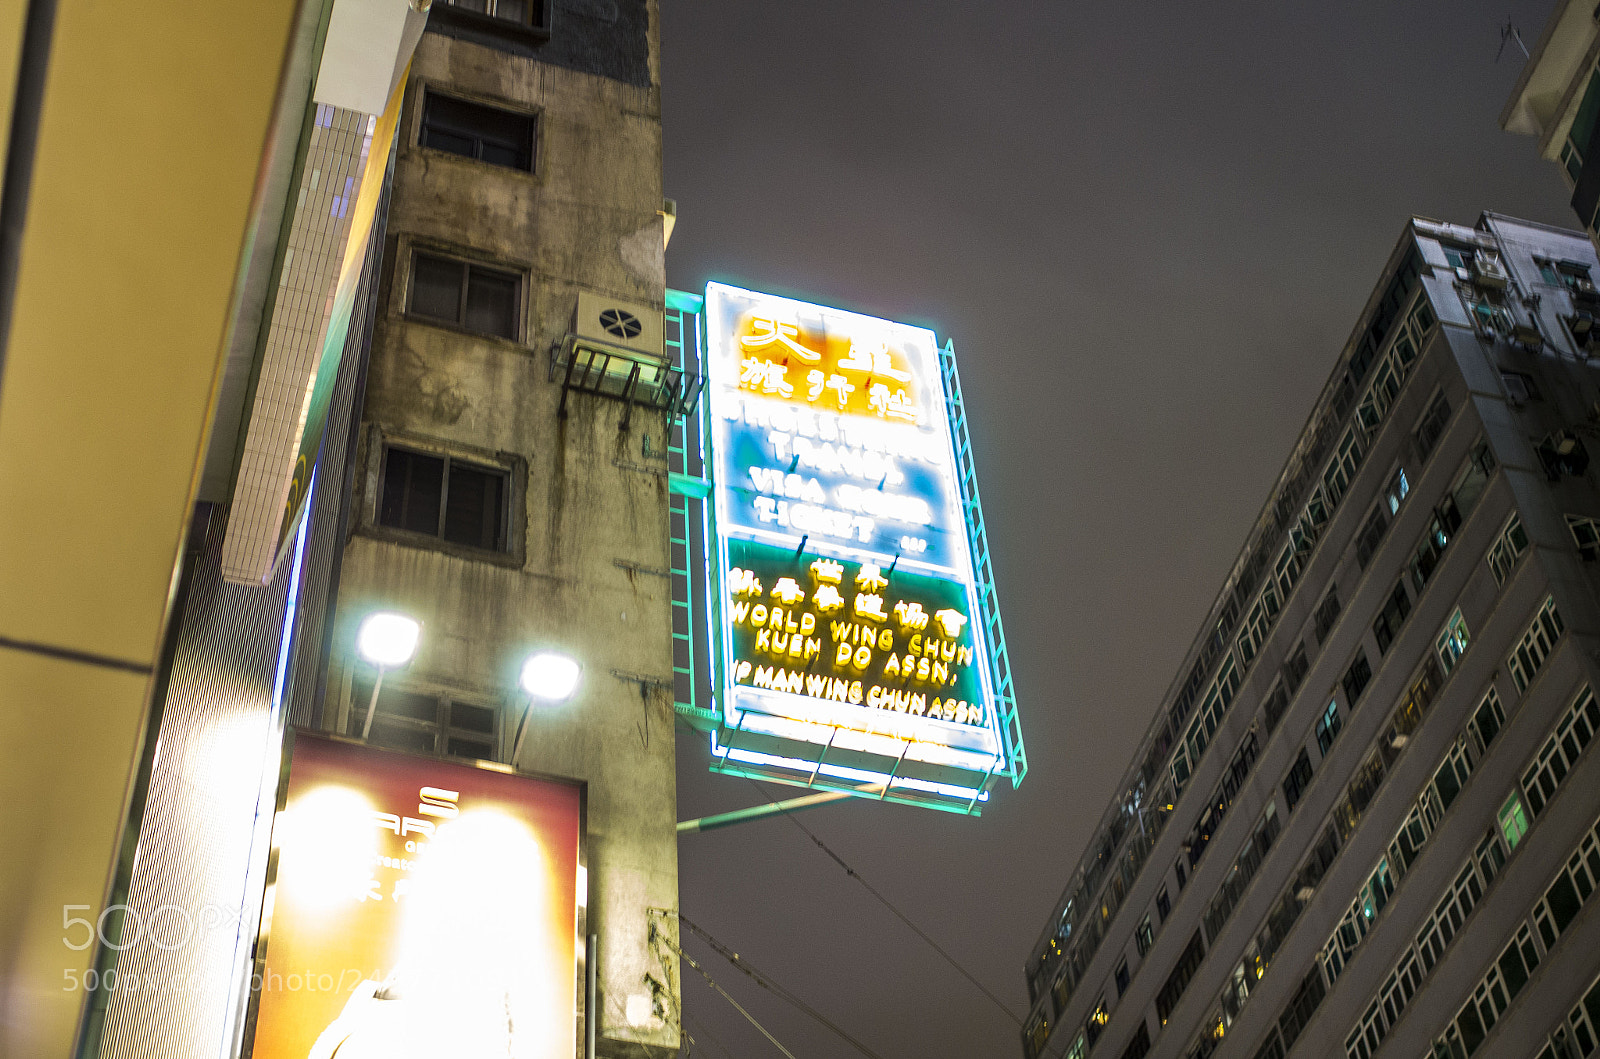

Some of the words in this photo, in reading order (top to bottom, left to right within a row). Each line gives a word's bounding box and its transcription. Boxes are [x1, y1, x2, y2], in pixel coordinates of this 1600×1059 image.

[748, 466, 826, 505] VISA
[731, 600, 816, 636] WORLD
[830, 620, 893, 652] WING
[908, 634, 973, 667] CHUN
[755, 628, 821, 662] KUEN
[836, 642, 872, 670] DO
[753, 664, 804, 695] MAN
[805, 673, 863, 706] WING
[866, 685, 926, 716] CHUN
